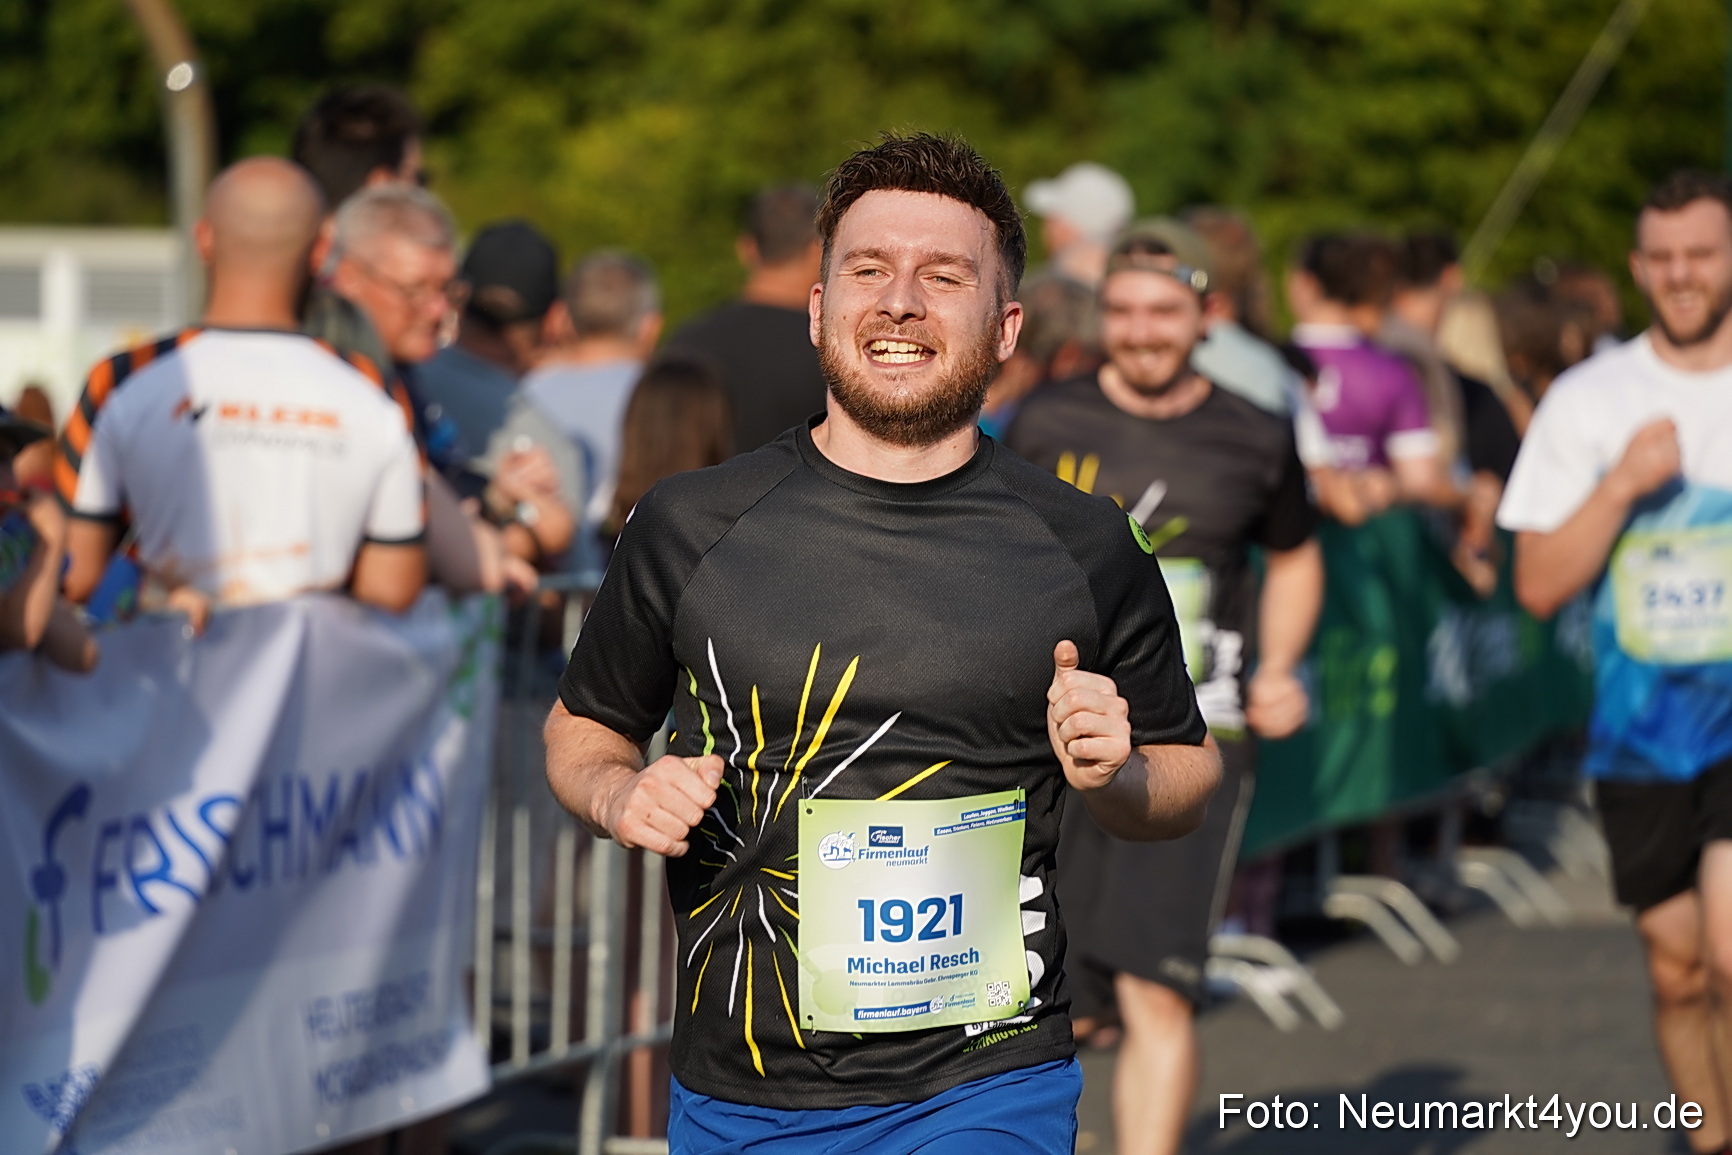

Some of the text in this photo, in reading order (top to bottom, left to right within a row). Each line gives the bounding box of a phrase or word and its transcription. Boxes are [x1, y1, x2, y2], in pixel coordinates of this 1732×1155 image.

[90, 752, 444, 934] FRISCHMANN
[858, 845, 929, 860] Firmenlauf
[886, 857, 928, 867] neumarkt
[857, 893, 963, 943] 1921
[847, 947, 980, 974] Michael Resch
[887, 978, 924, 987] Lammsbräu
[857, 1004, 928, 1019] firmenlauf.bayern
